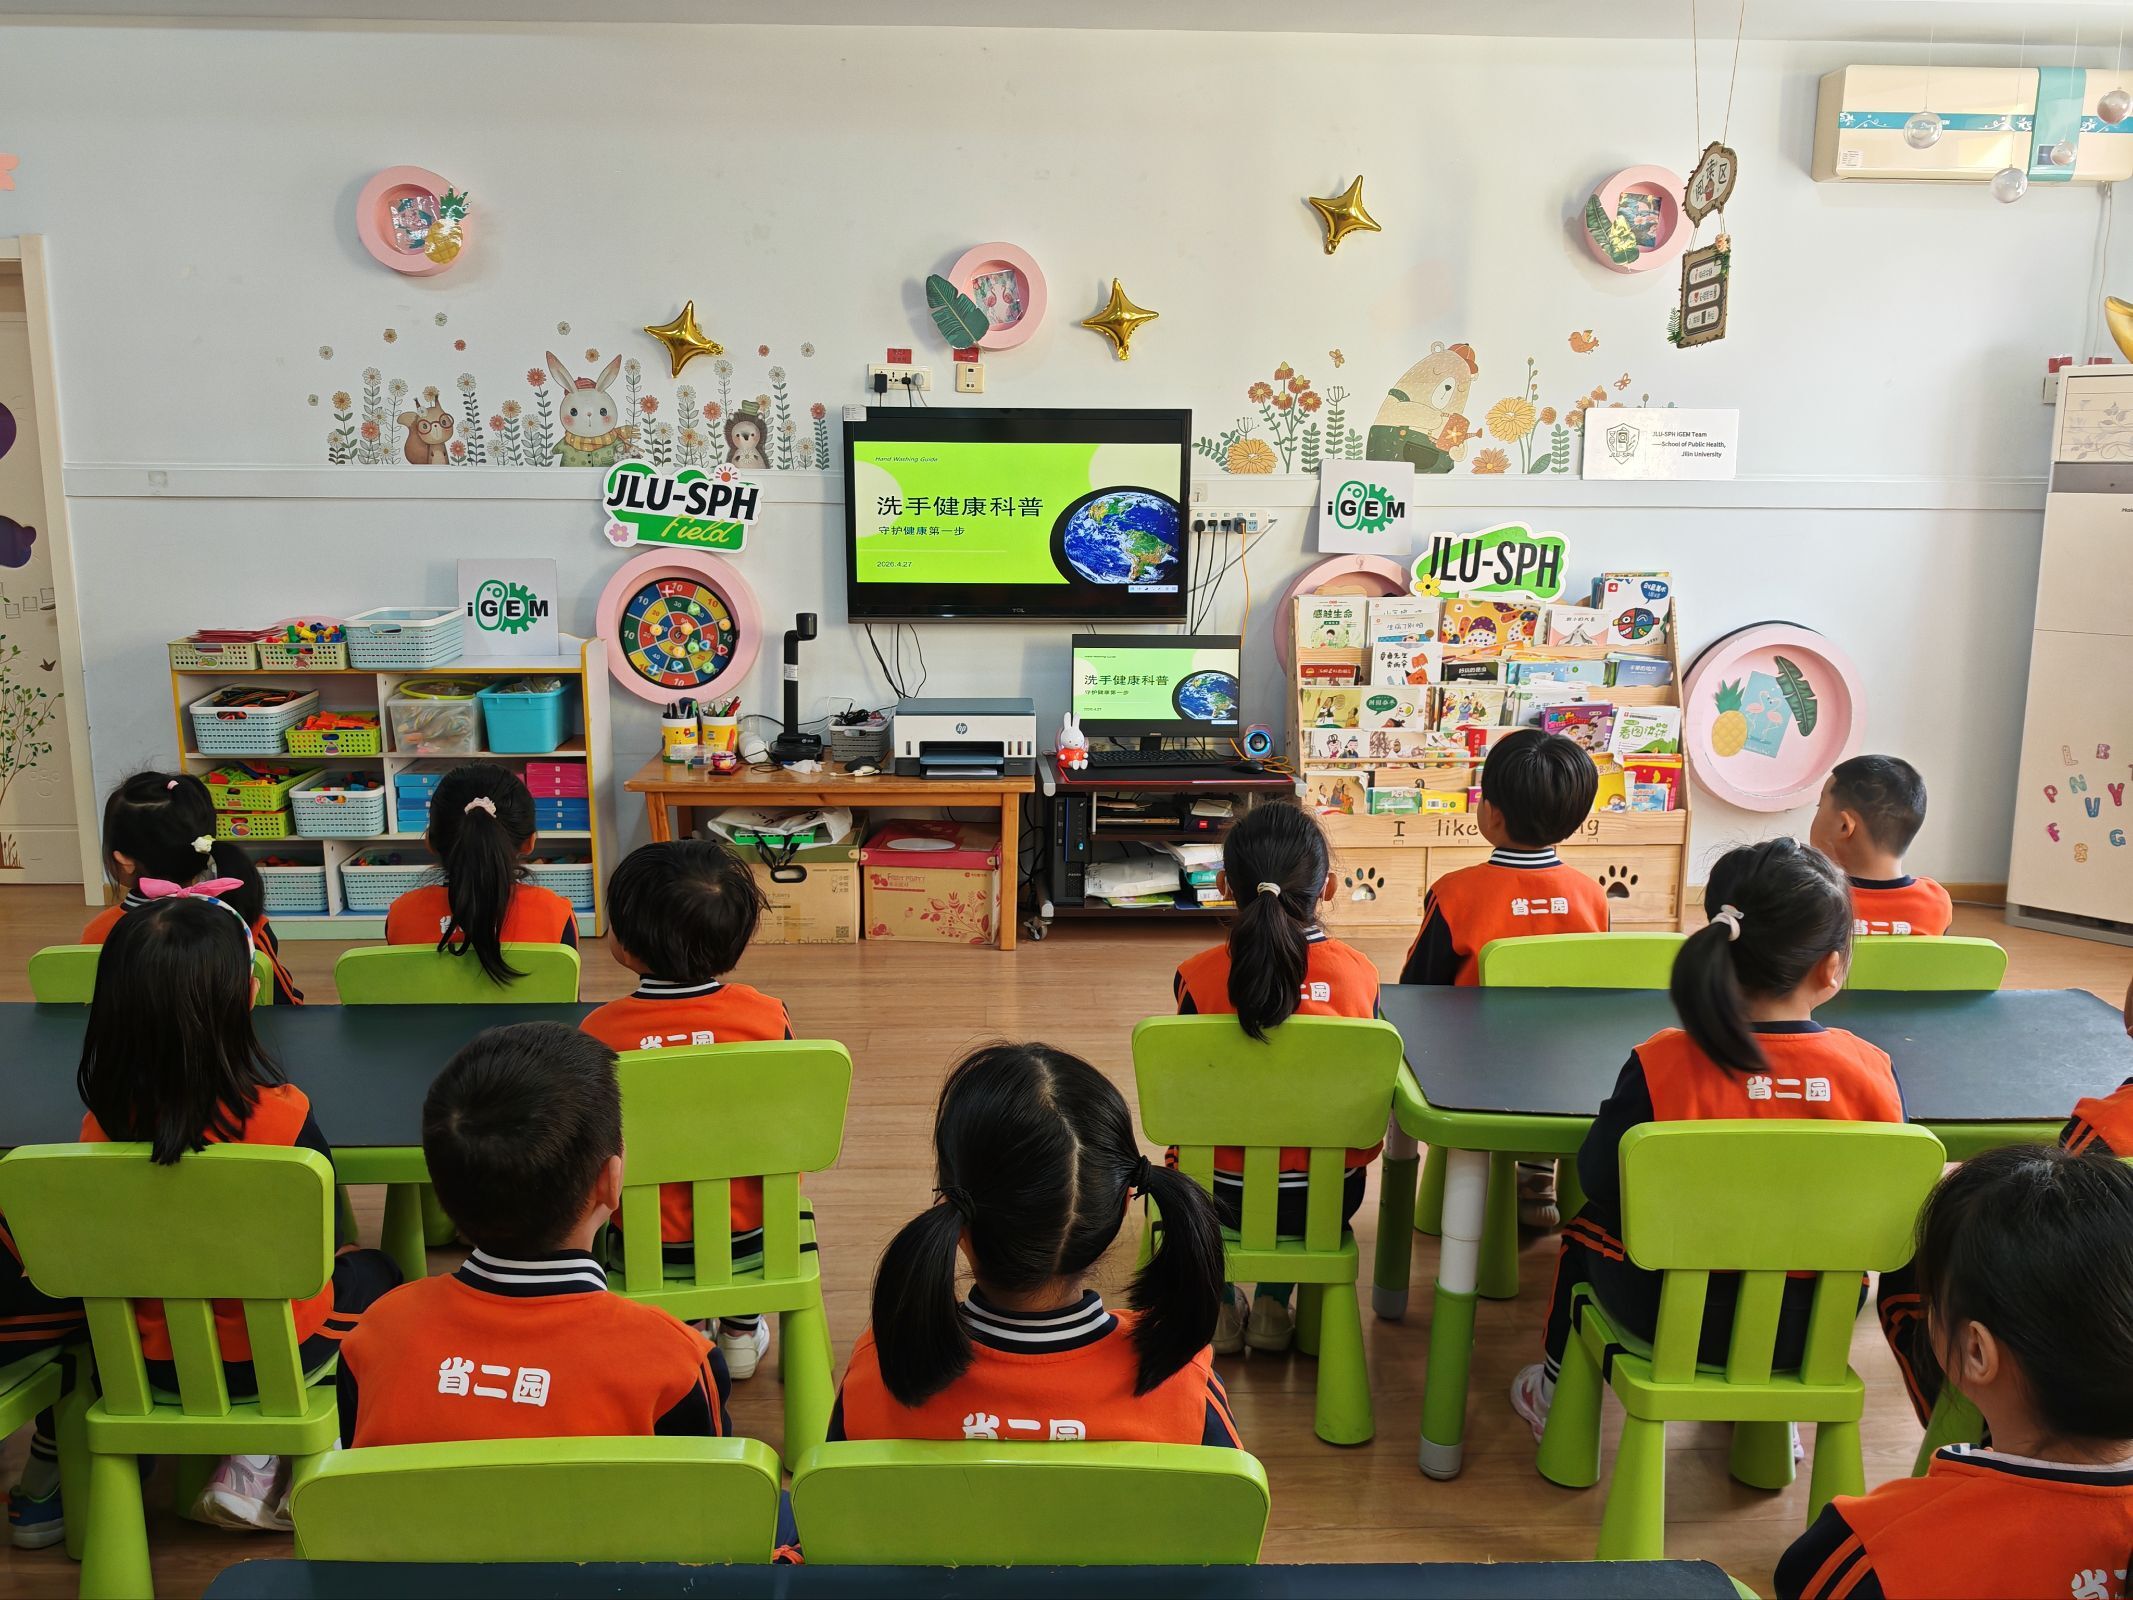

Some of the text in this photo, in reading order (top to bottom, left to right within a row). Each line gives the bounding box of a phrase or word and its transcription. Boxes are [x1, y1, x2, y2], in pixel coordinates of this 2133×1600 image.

[606, 474, 760, 520] JLU-SPH
[877, 496, 1044, 518] 洗手健康科普
[1327, 500, 1405, 518] iGEM
[660, 514, 741, 543] Field
[878, 526, 966, 536] 守护健康第一步
[1429, 536, 1561, 588] JLU-SPH
[672, 582, 683, 592] 10
[468, 599, 549, 618] iGEM
[638, 596, 649, 606] 10
[708, 598, 718, 608] 10
[1313, 609, 1353, 619] 感触生命
[624, 630, 635, 640] 10
[723, 633, 732, 642] 10
[674, 678, 684, 687] 10
[1084, 674, 1169, 686] 洗手健康科普
[2062, 744, 2078, 766] L
[2096, 744, 2110, 759] B
[2069, 774, 2088, 794] N
[2044, 785, 2058, 803] P
[2108, 783, 2125, 806] Y
[2084, 797, 2101, 818] V
[1394, 819, 1480, 838] I like
[2048, 822, 2060, 842] F
[2110, 829, 2126, 846] G
[1512, 896, 1569, 916] 省二园
[1746, 1076, 1831, 1102] 省二园
[438, 1356, 551, 1408] 省二园
